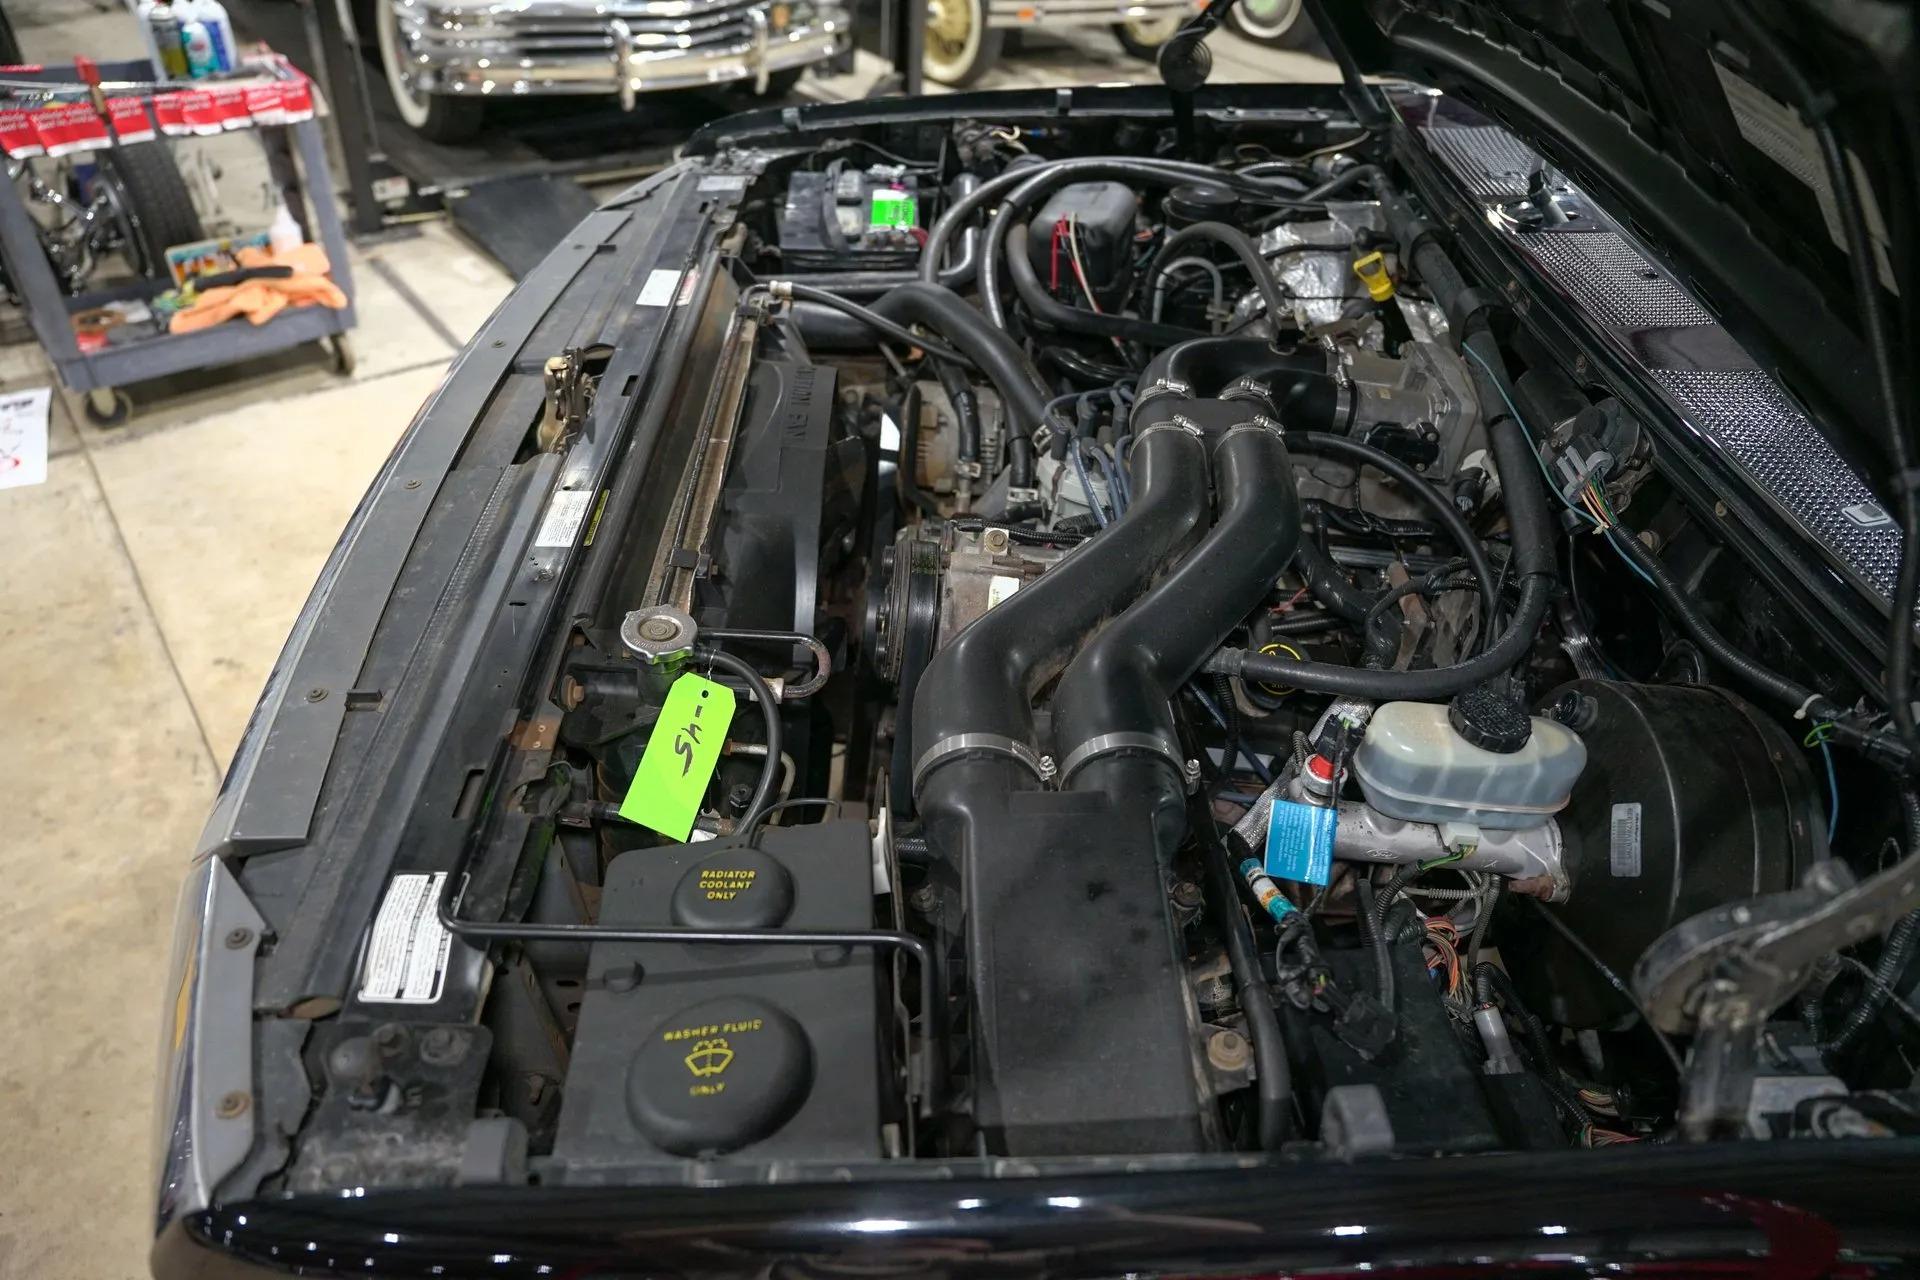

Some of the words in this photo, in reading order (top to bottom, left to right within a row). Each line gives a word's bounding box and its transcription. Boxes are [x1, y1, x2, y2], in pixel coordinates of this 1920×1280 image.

[701, 870, 755, 879] RADIATOR
[699, 880, 752, 889] COOLANT
[707, 891, 736, 900] ONLY
[664, 1025, 719, 1041] WASHER
[723, 1018, 762, 1033] FLUID
